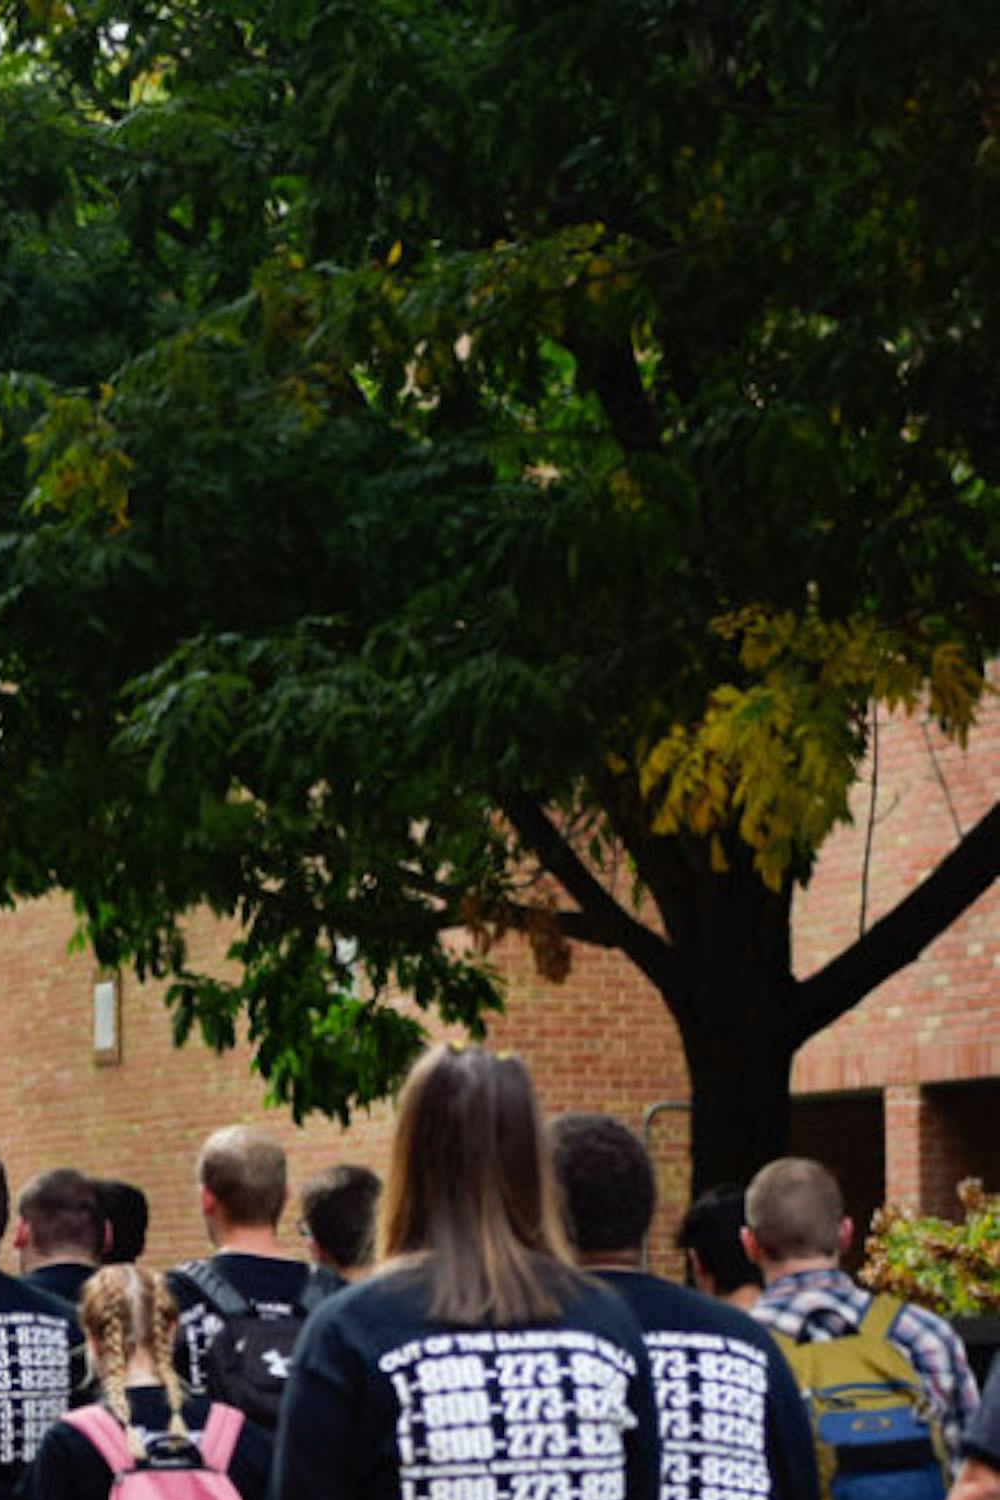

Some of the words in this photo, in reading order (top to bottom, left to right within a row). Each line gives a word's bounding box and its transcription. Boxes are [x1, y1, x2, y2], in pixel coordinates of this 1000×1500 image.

[378, 1341, 422, 1372] OUT
[423, 1335, 453, 1355] OF
[455, 1333, 494, 1351] THE
